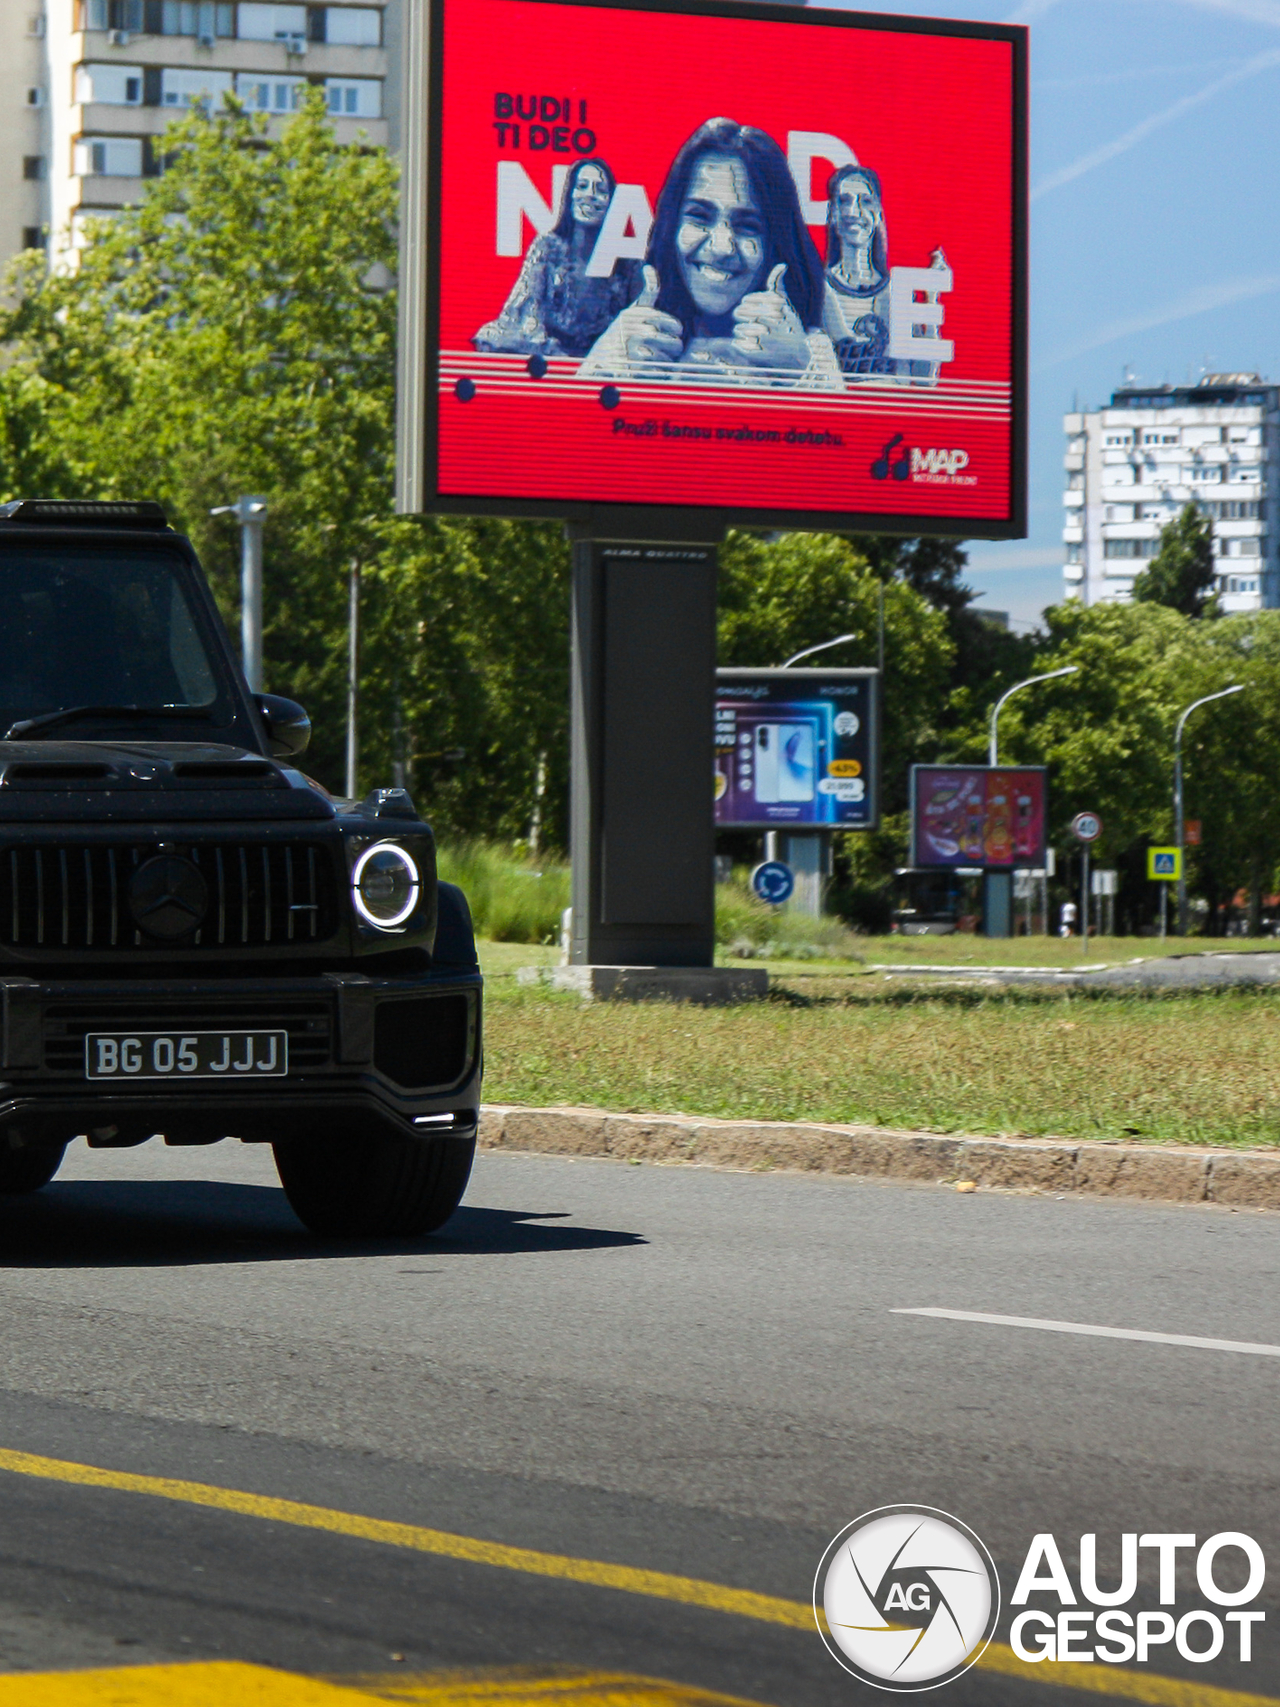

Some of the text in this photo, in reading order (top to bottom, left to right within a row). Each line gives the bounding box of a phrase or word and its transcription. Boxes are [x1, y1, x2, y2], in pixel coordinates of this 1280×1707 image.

[494, 92, 587, 125] BUDI I
[493, 123, 597, 154] TI DEO
[911, 447, 969, 475] MAP
[1079, 819, 1096, 834] 40
[97, 1036, 277, 1073] BG 05 JJJ
